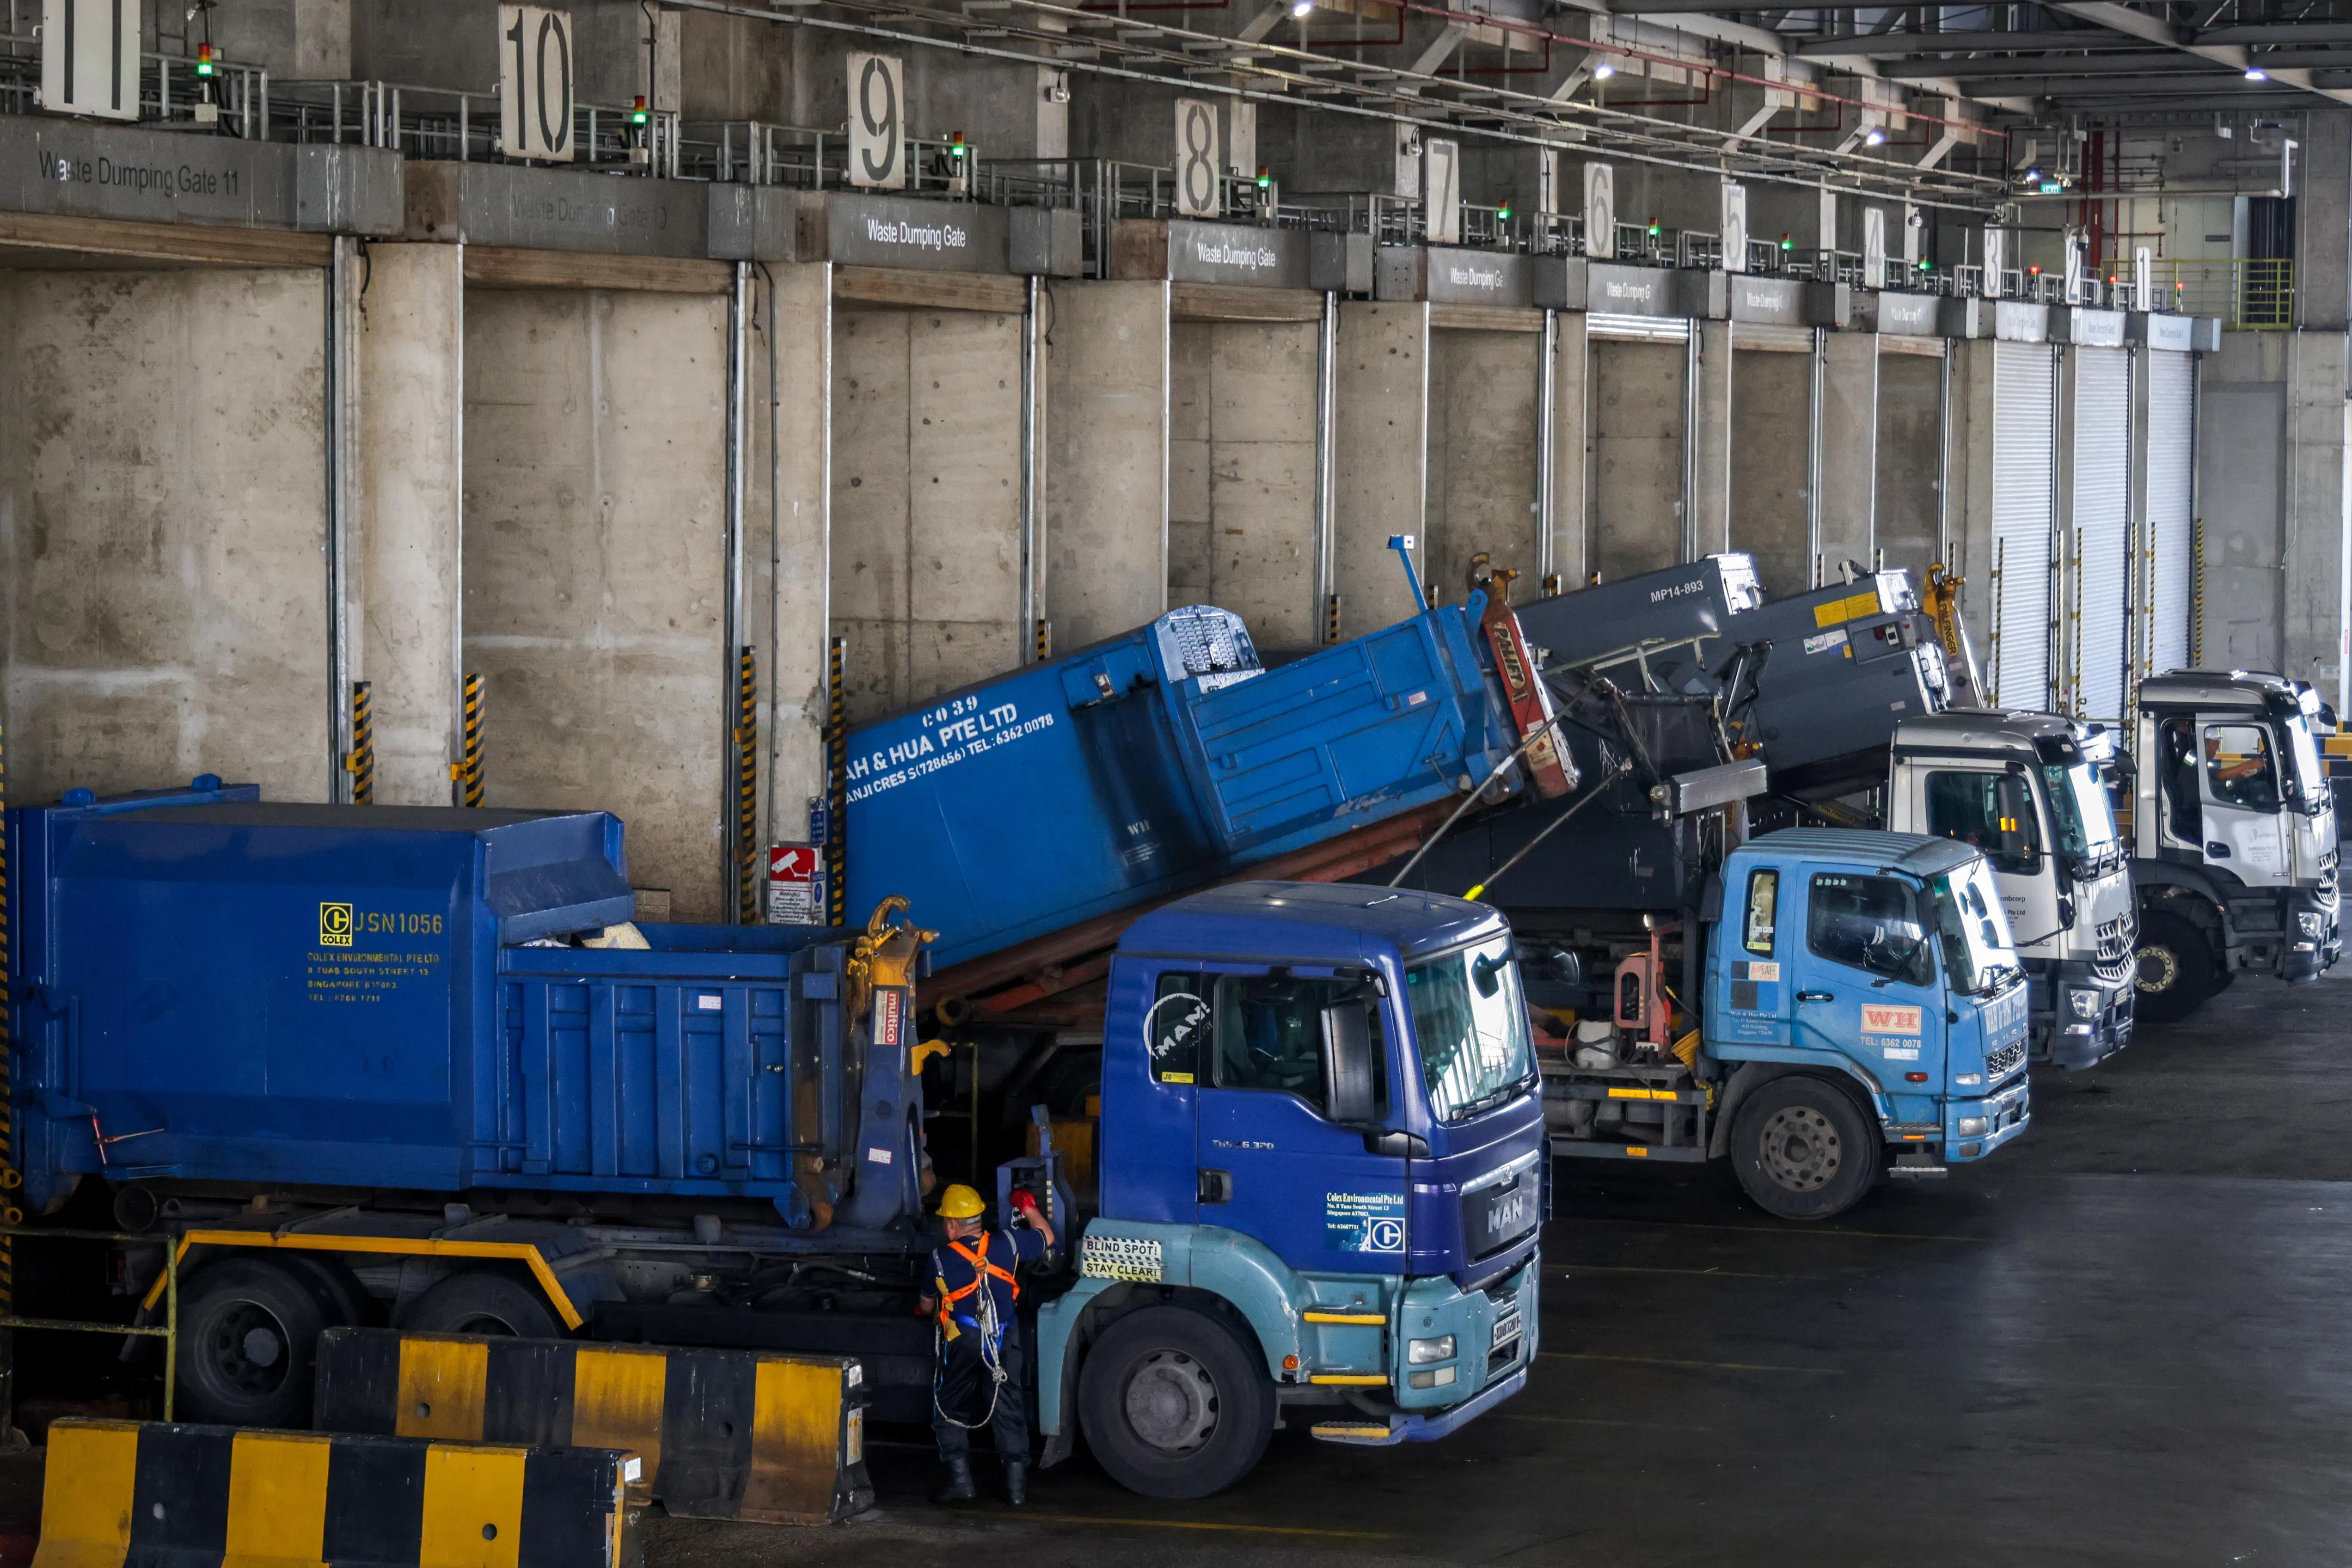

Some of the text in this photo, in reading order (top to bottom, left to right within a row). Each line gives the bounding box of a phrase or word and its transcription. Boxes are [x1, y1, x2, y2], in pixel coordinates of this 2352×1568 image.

[507, 8, 570, 154] 10
[860, 57, 897, 182] 9
[1185, 104, 1213, 212] 8
[98, 157, 173, 197] Dumping
[179, 165, 216, 195] Gate
[224, 170, 238, 196] 11
[1433, 143, 1453, 236] 7
[2046, 185, 2058, 194] EXIT
[1591, 167, 1609, 253] 6
[1726, 188, 1742, 267] 5
[868, 219, 966, 251] Waste Dumping Gate
[1868, 211, 1882, 285] 4
[1198, 242, 1275, 270] Waste Dumping Gate
[1987, 229, 1998, 294] 3
[2069, 239, 2079, 301] 2
[1450, 267, 1468, 284] Waste
[1470, 268, 1494, 290] Dumping
[1606, 281, 1622, 297] Waste
[1623, 282, 1644, 302] Dumping
[2140, 249, 2145, 307] 1
[1746, 292, 1760, 307] Waste
[1760, 293, 1778, 312] Dumping
[1650, 580, 1704, 603] MP14-893
[1940, 602, 1956, 655] PALFINGER
[872, 752, 888, 772] &
[888, 735, 934, 766] HUA
[938, 717, 979, 748] PTE
[980, 703, 1017, 732] LTD
[873, 770, 906, 793] CRES
[907, 747, 966, 780] S(728656)
[1024, 713, 1054, 735] 0078
[322, 935, 350, 945] COLEX
[354, 912, 442, 934] JSN1056
[307, 952, 439, 963] COLEX ENVIRONMENTAL PTE LTD
[307, 980, 360, 988] SINGAPORE
[887, 993, 898, 1042] multico
[1866, 1011, 1917, 1029] WH
[1860, 1036, 1922, 1048] TEL: 6362 0078
[1327, 1192, 1404, 1204] Colex Environmental Pte Ltd
[1488, 1195, 1523, 1233] MAN
[1087, 1241, 1157, 1256] BLIND SPOT!
[1086, 1263, 1157, 1276] STAY CLEAR!
